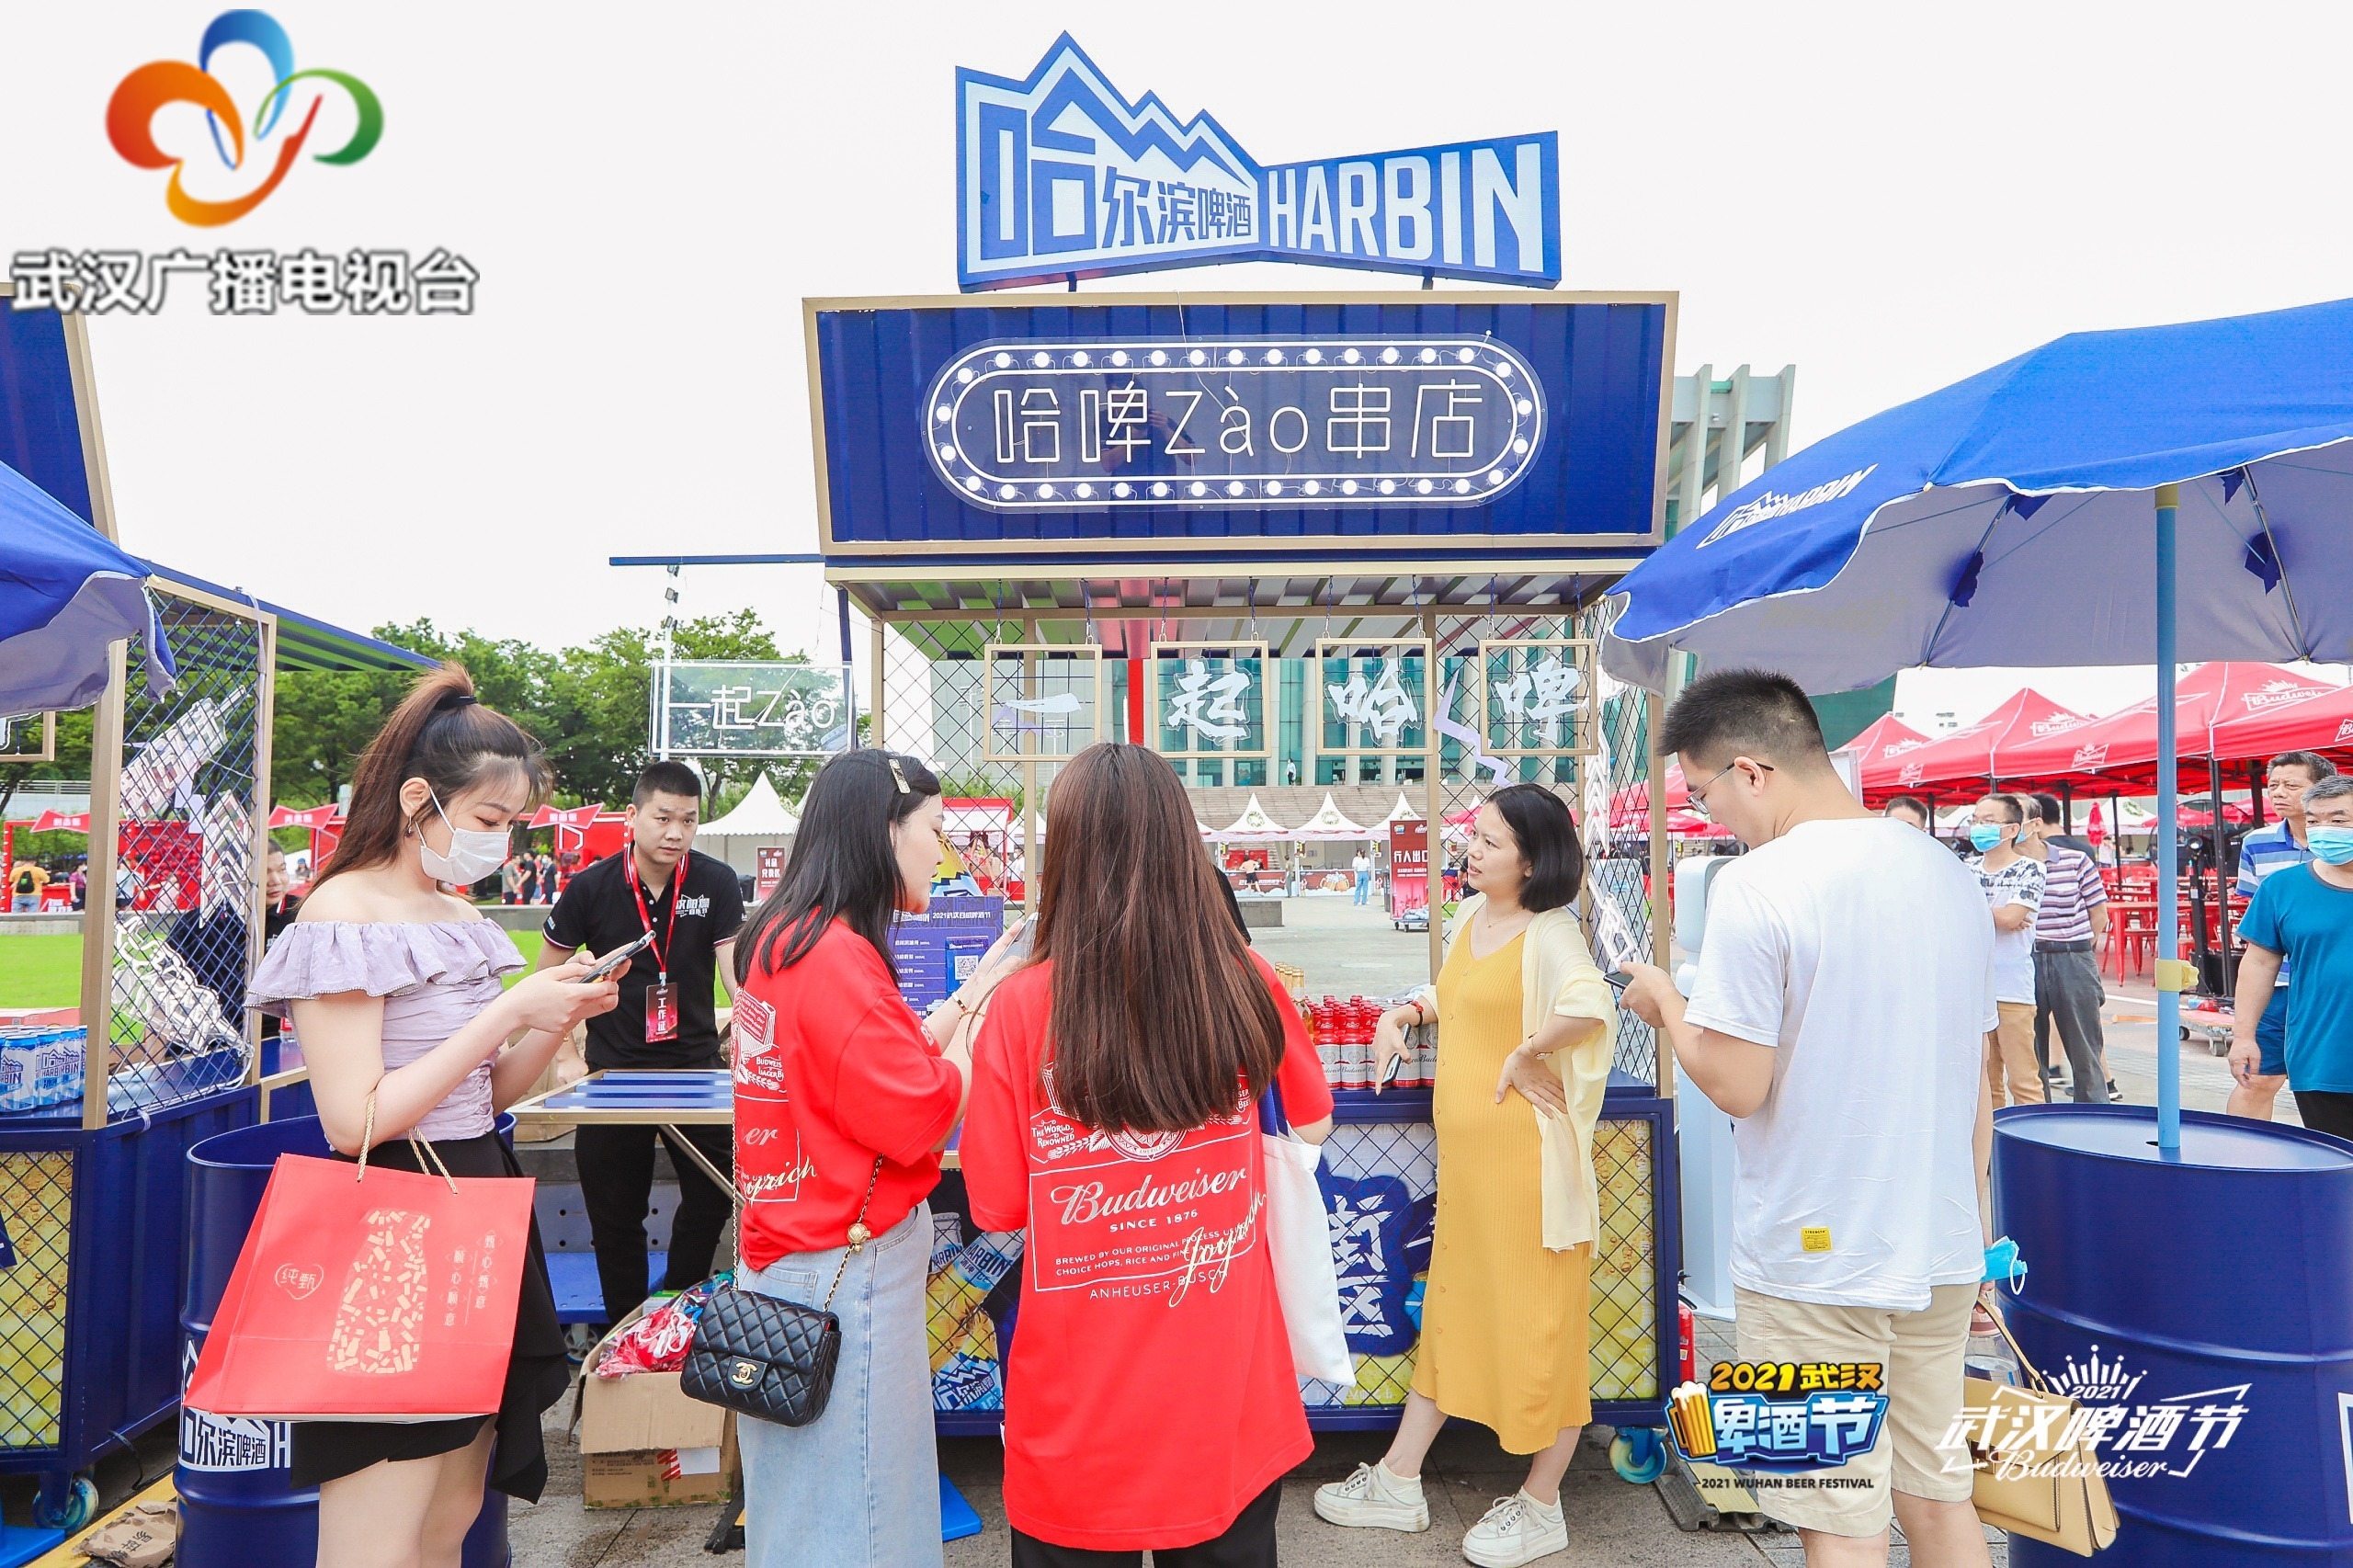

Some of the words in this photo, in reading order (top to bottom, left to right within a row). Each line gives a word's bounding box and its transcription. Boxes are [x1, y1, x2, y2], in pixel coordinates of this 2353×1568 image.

[980, 66, 1251, 260] 哈尔滨啤酒
[1268, 142, 1543, 273] HARBIN
[995, 378, 1483, 463] 哈啤Zào串店
[657, 996, 667, 1032] 工作证
[41, 1065, 62, 1077] HARBI
[756, 1056, 782, 1068] BUDWEIS
[1031, 1127, 1044, 1137] THE
[1037, 1133, 1074, 1148] RENOWNED
[1139, 1145, 1163, 1153] AMERICA
[745, 1155, 817, 1208] oyrich
[1051, 1167, 1246, 1225] Budweiser
[1109, 1219, 1157, 1232] SINCE
[1166, 1209, 1198, 1225] 1876
[964, 1244, 1010, 1278] HARBIN
[1055, 1255, 1096, 1266] BREWED
[1112, 1247, 1132, 1256] OUR
[1135, 1242, 1179, 1253] ORIGINAL
[1182, 1231, 1220, 1244] PROCESS
[281, 1267, 316, 1290] 纯甄
[1056, 1266, 1091, 1276] CHOICE
[1095, 1258, 1122, 1269] HOPS,
[1150, 1254, 1170, 1263] AND
